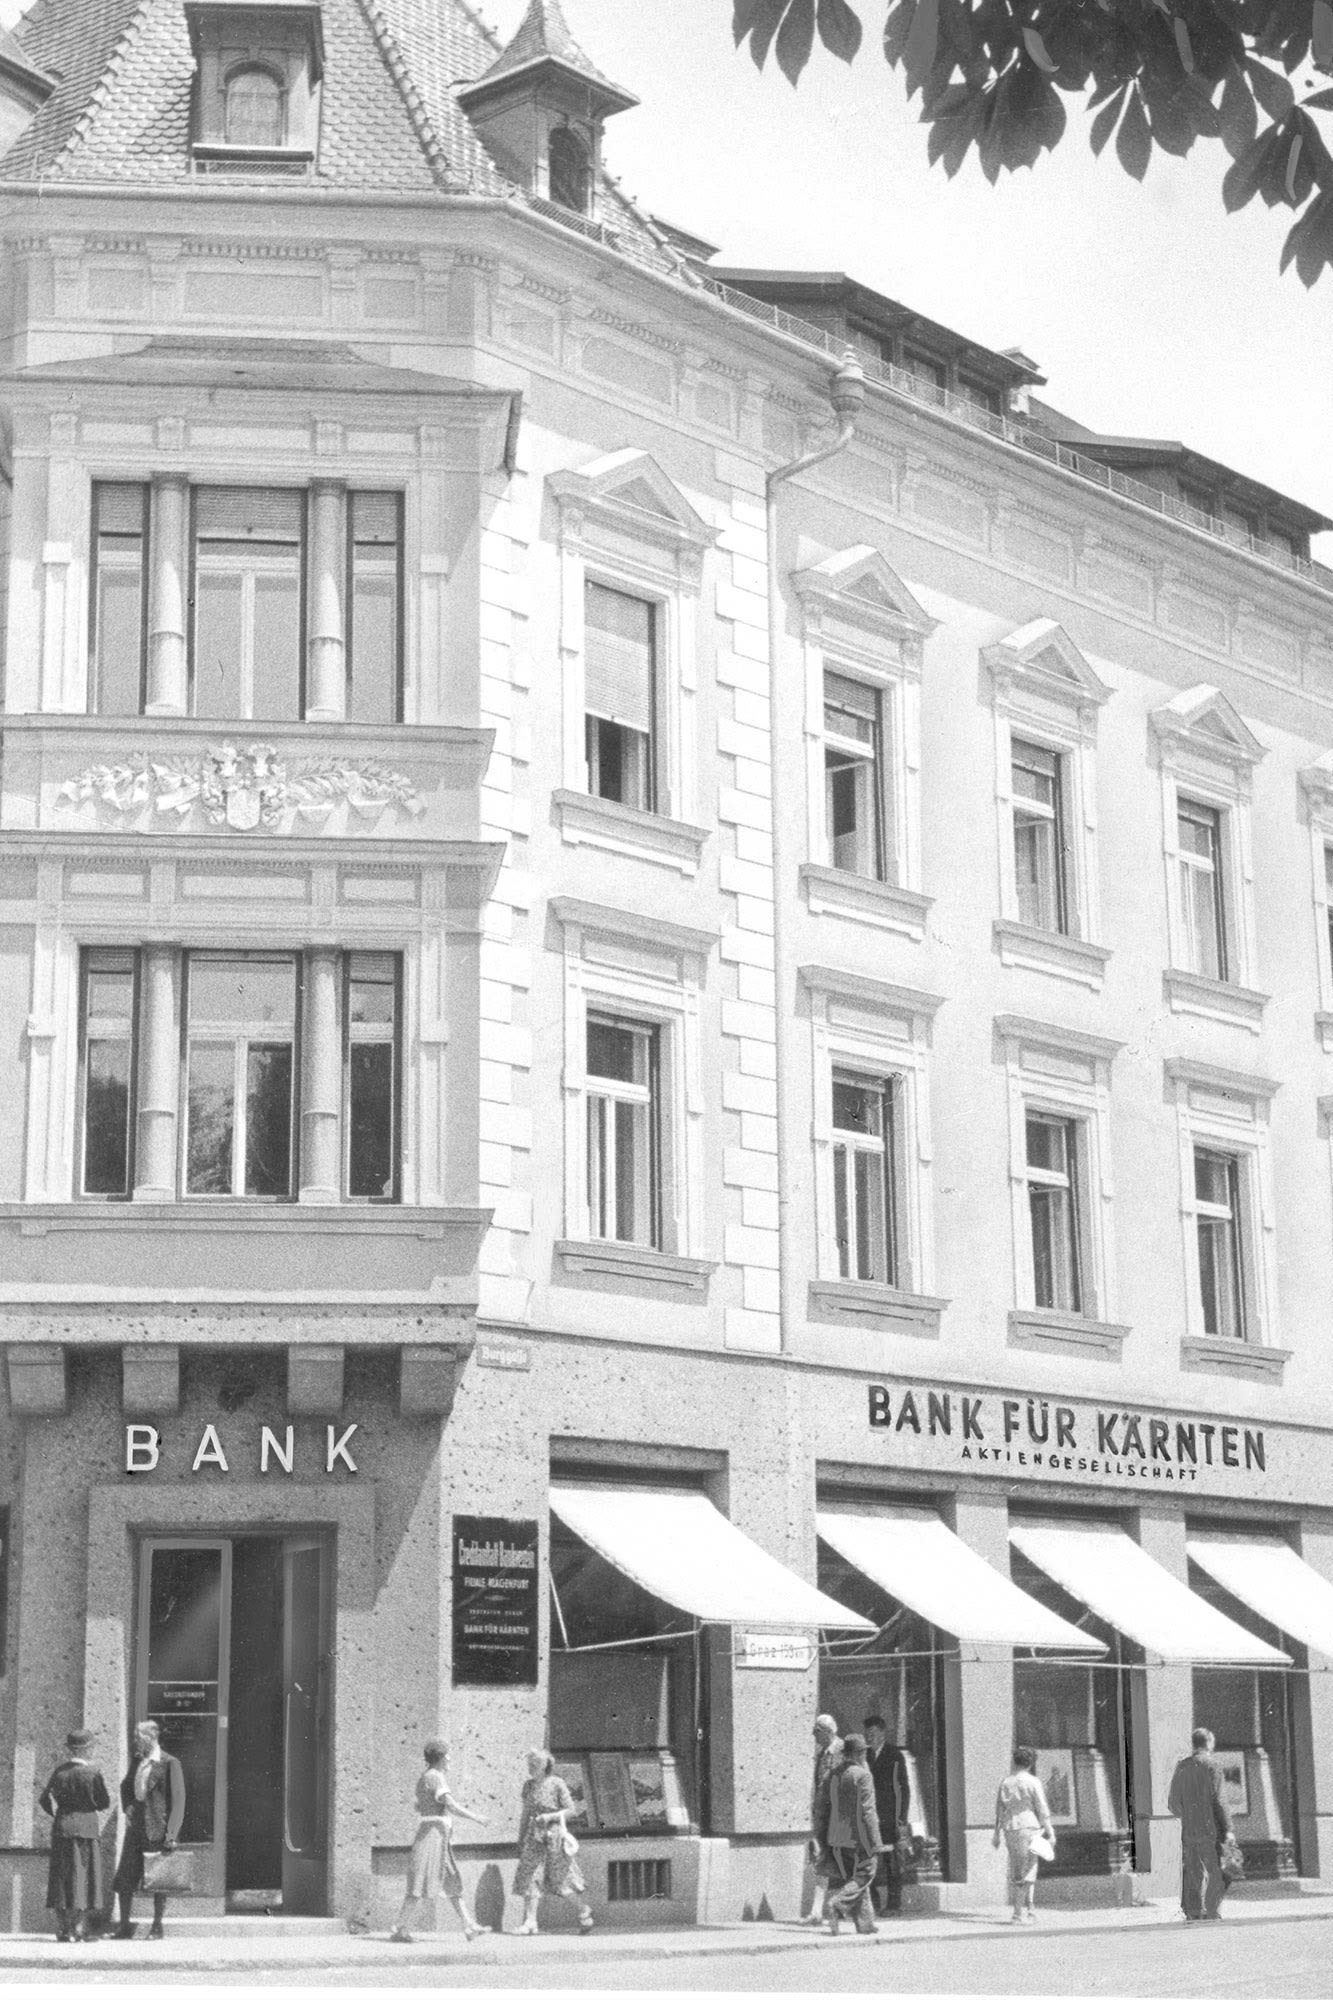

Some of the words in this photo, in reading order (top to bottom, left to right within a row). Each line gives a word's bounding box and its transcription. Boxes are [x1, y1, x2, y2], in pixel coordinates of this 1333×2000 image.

[126, 1423, 358, 1472] BANK
[868, 1385, 985, 1440] BANK
[1003, 1398, 1078, 1449] FÜR
[1098, 1412, 1266, 1472] KÄRNTEN
[961, 1445, 1198, 1480] AKTIENGESELLSCHAFT
[751, 1643, 776, 1658] Graz
